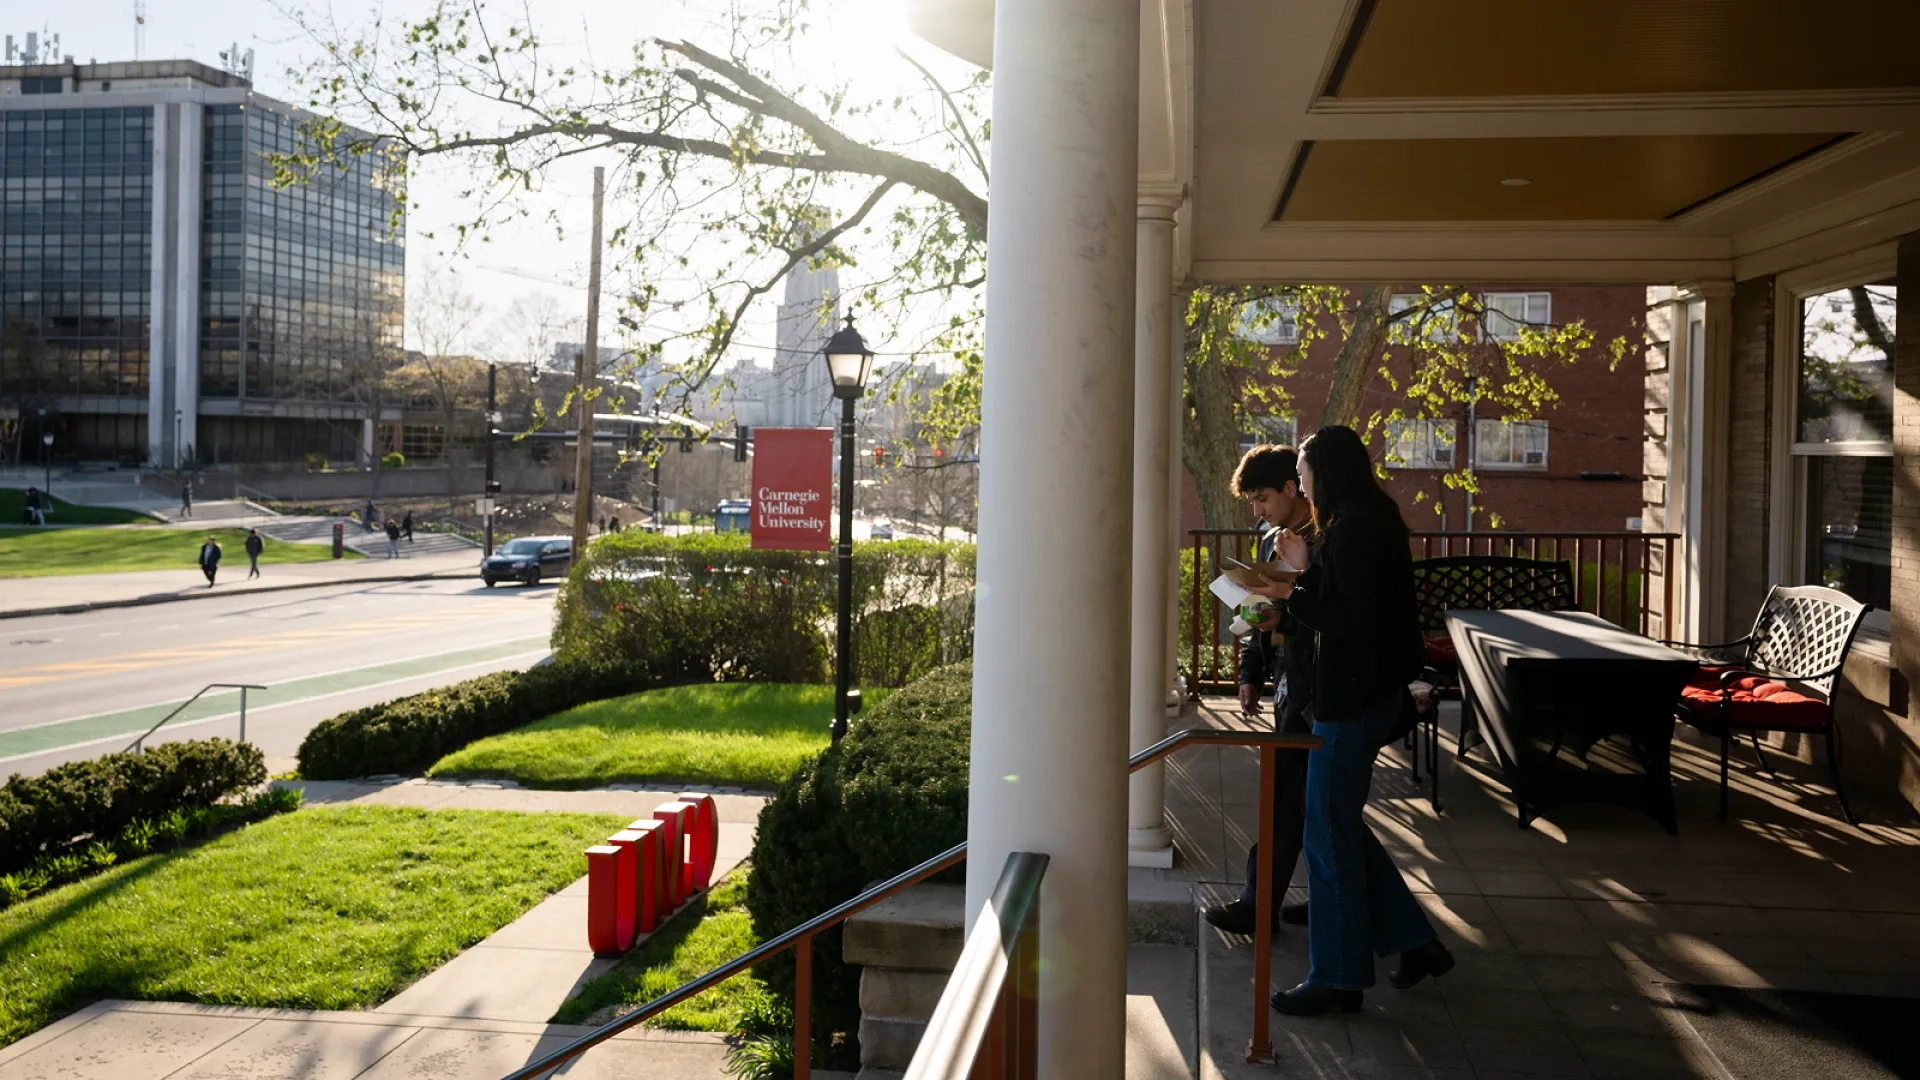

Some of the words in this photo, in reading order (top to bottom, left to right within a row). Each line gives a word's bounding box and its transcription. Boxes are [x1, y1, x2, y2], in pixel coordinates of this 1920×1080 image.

[758, 486, 820, 505] Carnegie
[758, 501, 805, 515] Mellon
[759, 514, 826, 533] University
